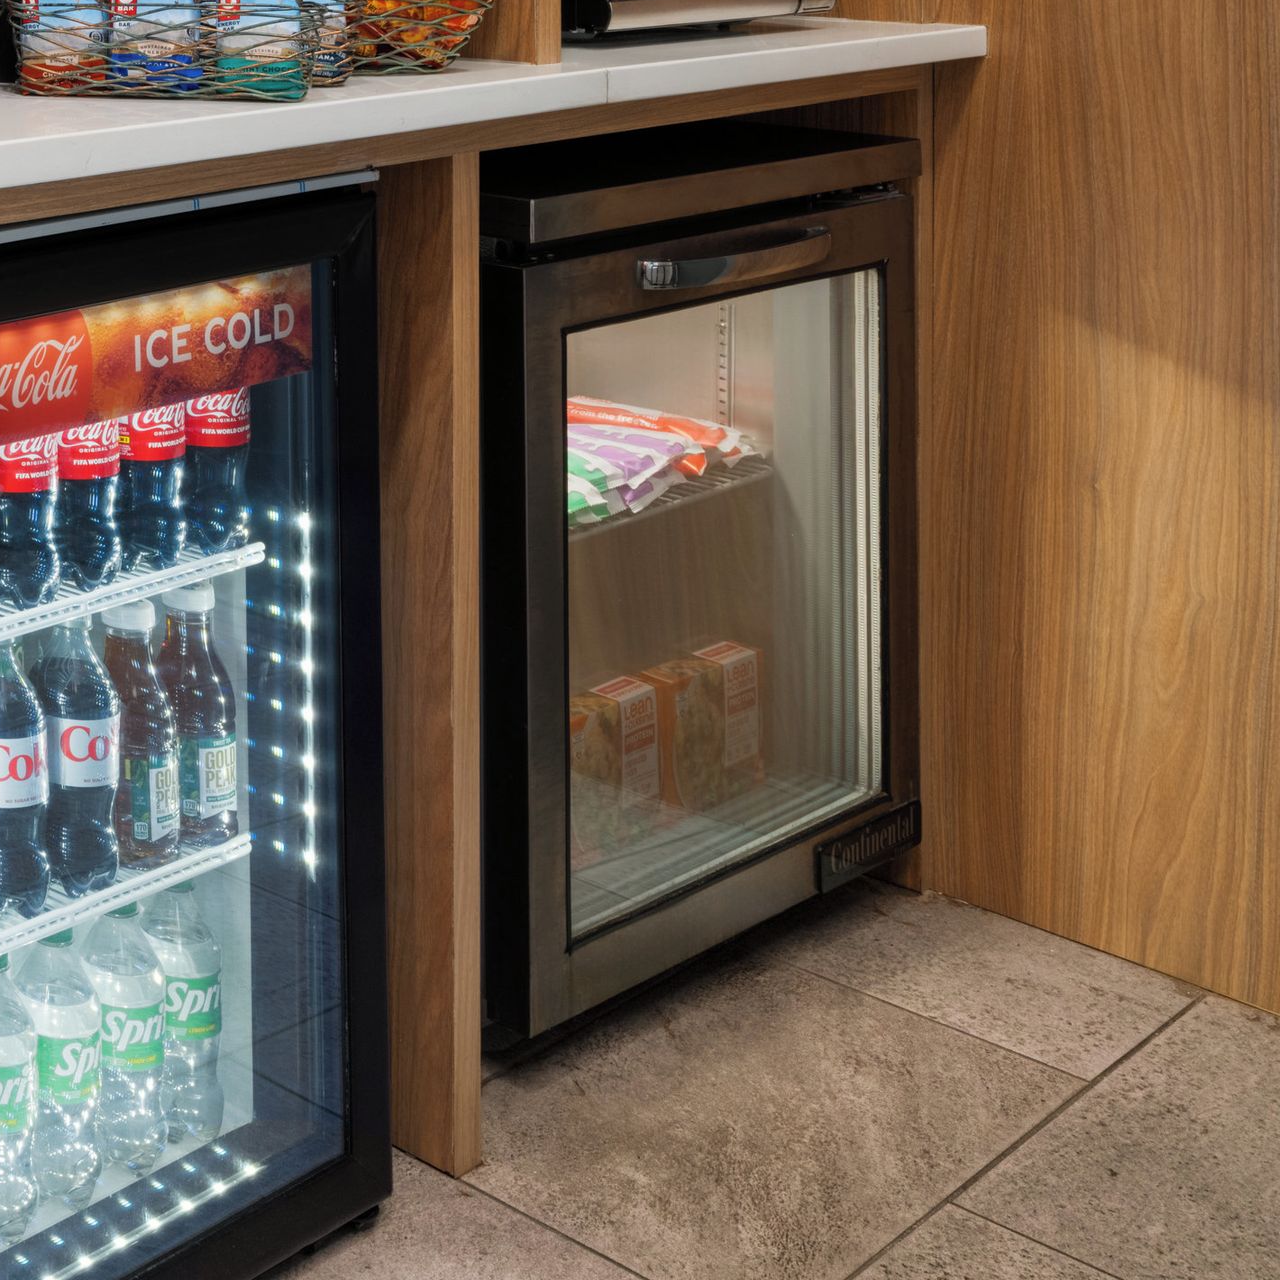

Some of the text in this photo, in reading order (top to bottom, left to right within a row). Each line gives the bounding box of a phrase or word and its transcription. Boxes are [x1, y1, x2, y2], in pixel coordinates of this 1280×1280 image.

[218, 20, 240, 28] ENERGY
[133, 302, 296, 373] ICE COLD
[597, 411, 615, 422] the
[201, 426, 237, 435] FIFA WORLD
[78, 445, 109, 454] ORIGINAL
[148, 439, 180, 449] FIFA WORLD
[20, 459, 49, 467] ORIGINAL
[73, 456, 108, 466] FIFA WORLD
[15, 470, 50, 480] FIFA WORLD
[623, 696, 654, 720] Lean
[204, 746, 236, 770] GOLD
[205, 766, 236, 789] PEAK
[831, 806, 914, 873] Continental
[164, 981, 221, 1021] Spri
[101, 1005, 165, 1052] Spri
